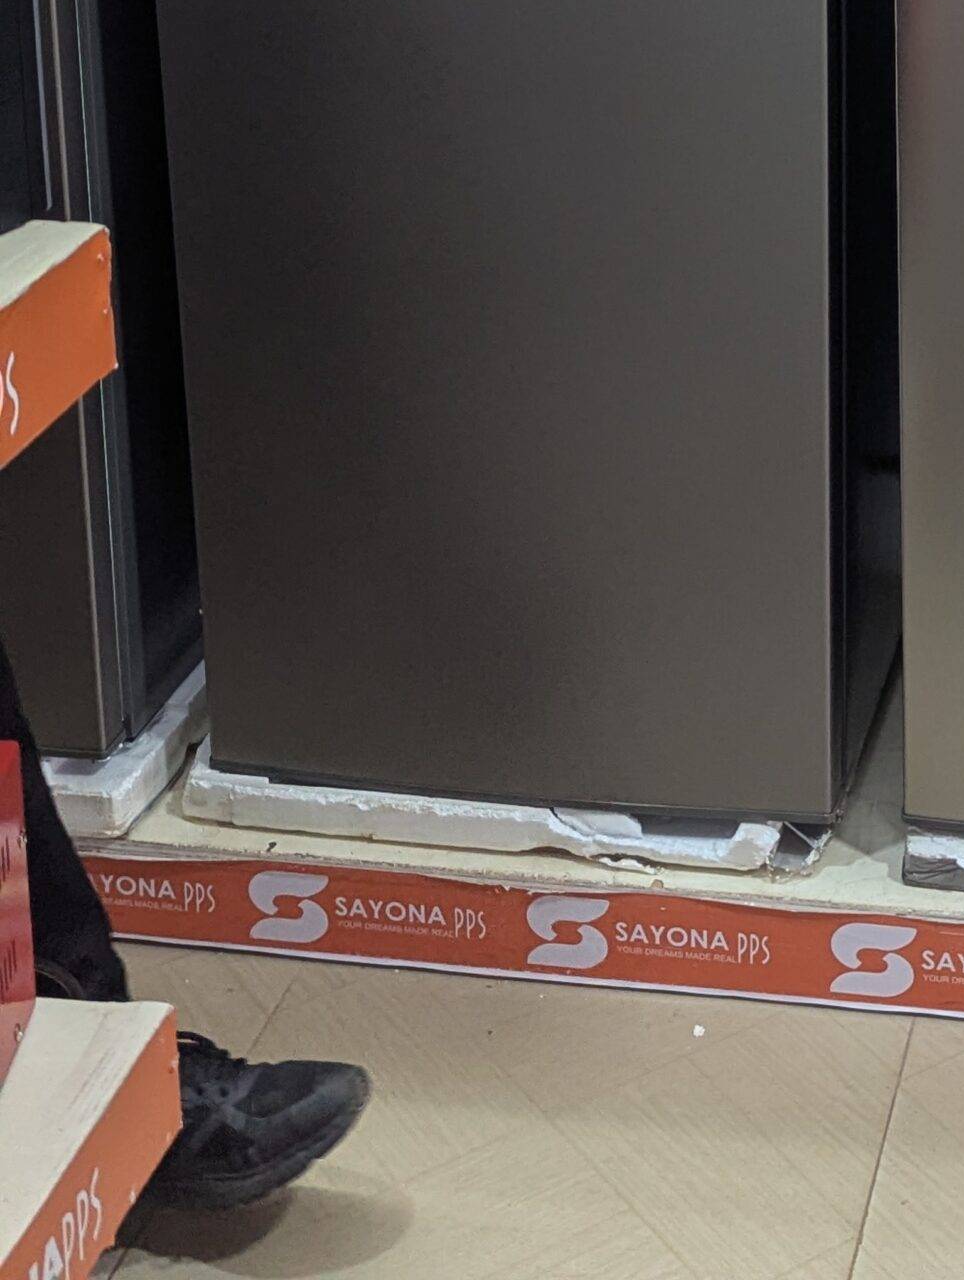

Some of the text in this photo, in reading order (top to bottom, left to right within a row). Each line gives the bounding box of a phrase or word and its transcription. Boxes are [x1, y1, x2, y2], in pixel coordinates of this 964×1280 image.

[335, 897, 447, 926] SAYONA
[615, 921, 730, 951] SAYONA
[616, 944, 737, 964] YOUR DREAMS MADE REAL
[922, 973, 950, 984] YOUR
